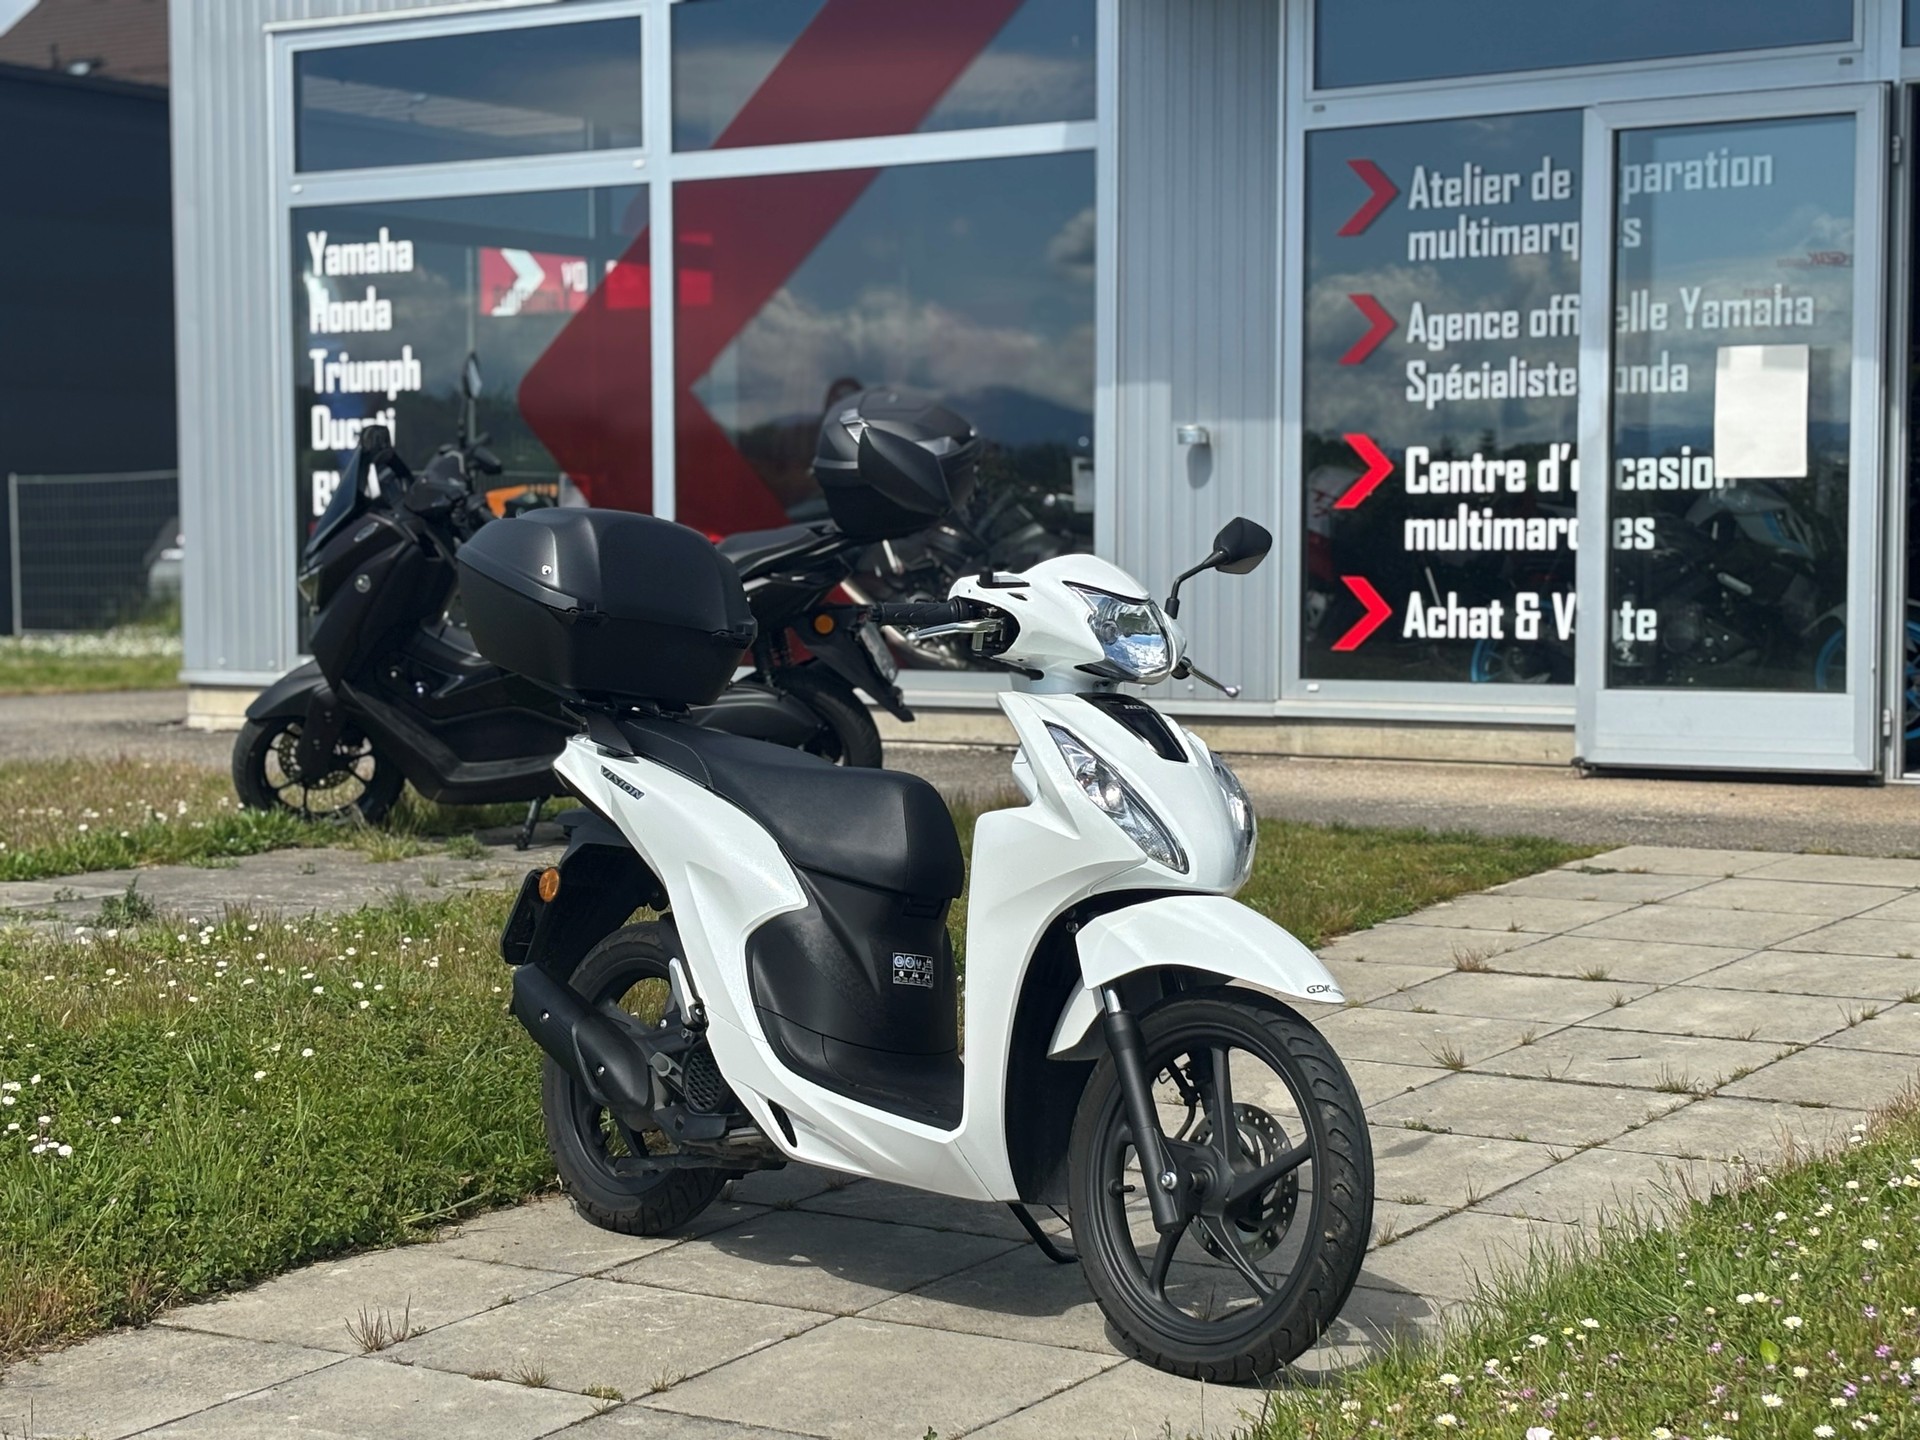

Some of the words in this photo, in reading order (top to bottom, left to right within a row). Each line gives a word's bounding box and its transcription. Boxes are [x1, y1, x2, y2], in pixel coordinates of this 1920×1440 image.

[1408, 162, 1520, 210] Atelier
[1531, 156, 1571, 201] de
[1622, 148, 1773, 204] paration
[307, 227, 413, 277] Yamaha
[1408, 214, 1641, 261] multimarqs
[309, 285, 392, 334] Honda
[1406, 301, 1518, 351] Agence
[1529, 289, 1667, 338] offielle
[1679, 284, 1814, 330] Yamaha
[309, 345, 421, 400] Triumph
[1405, 356, 1578, 410] Spécialiste
[1616, 350, 1688, 394] onda
[1405, 446, 1526, 494] Centre
[1403, 591, 1504, 640] Achat
[1514, 592, 1542, 640] &
[1551, 592, 1657, 641] Vte
[600, 765, 645, 800] VISION
